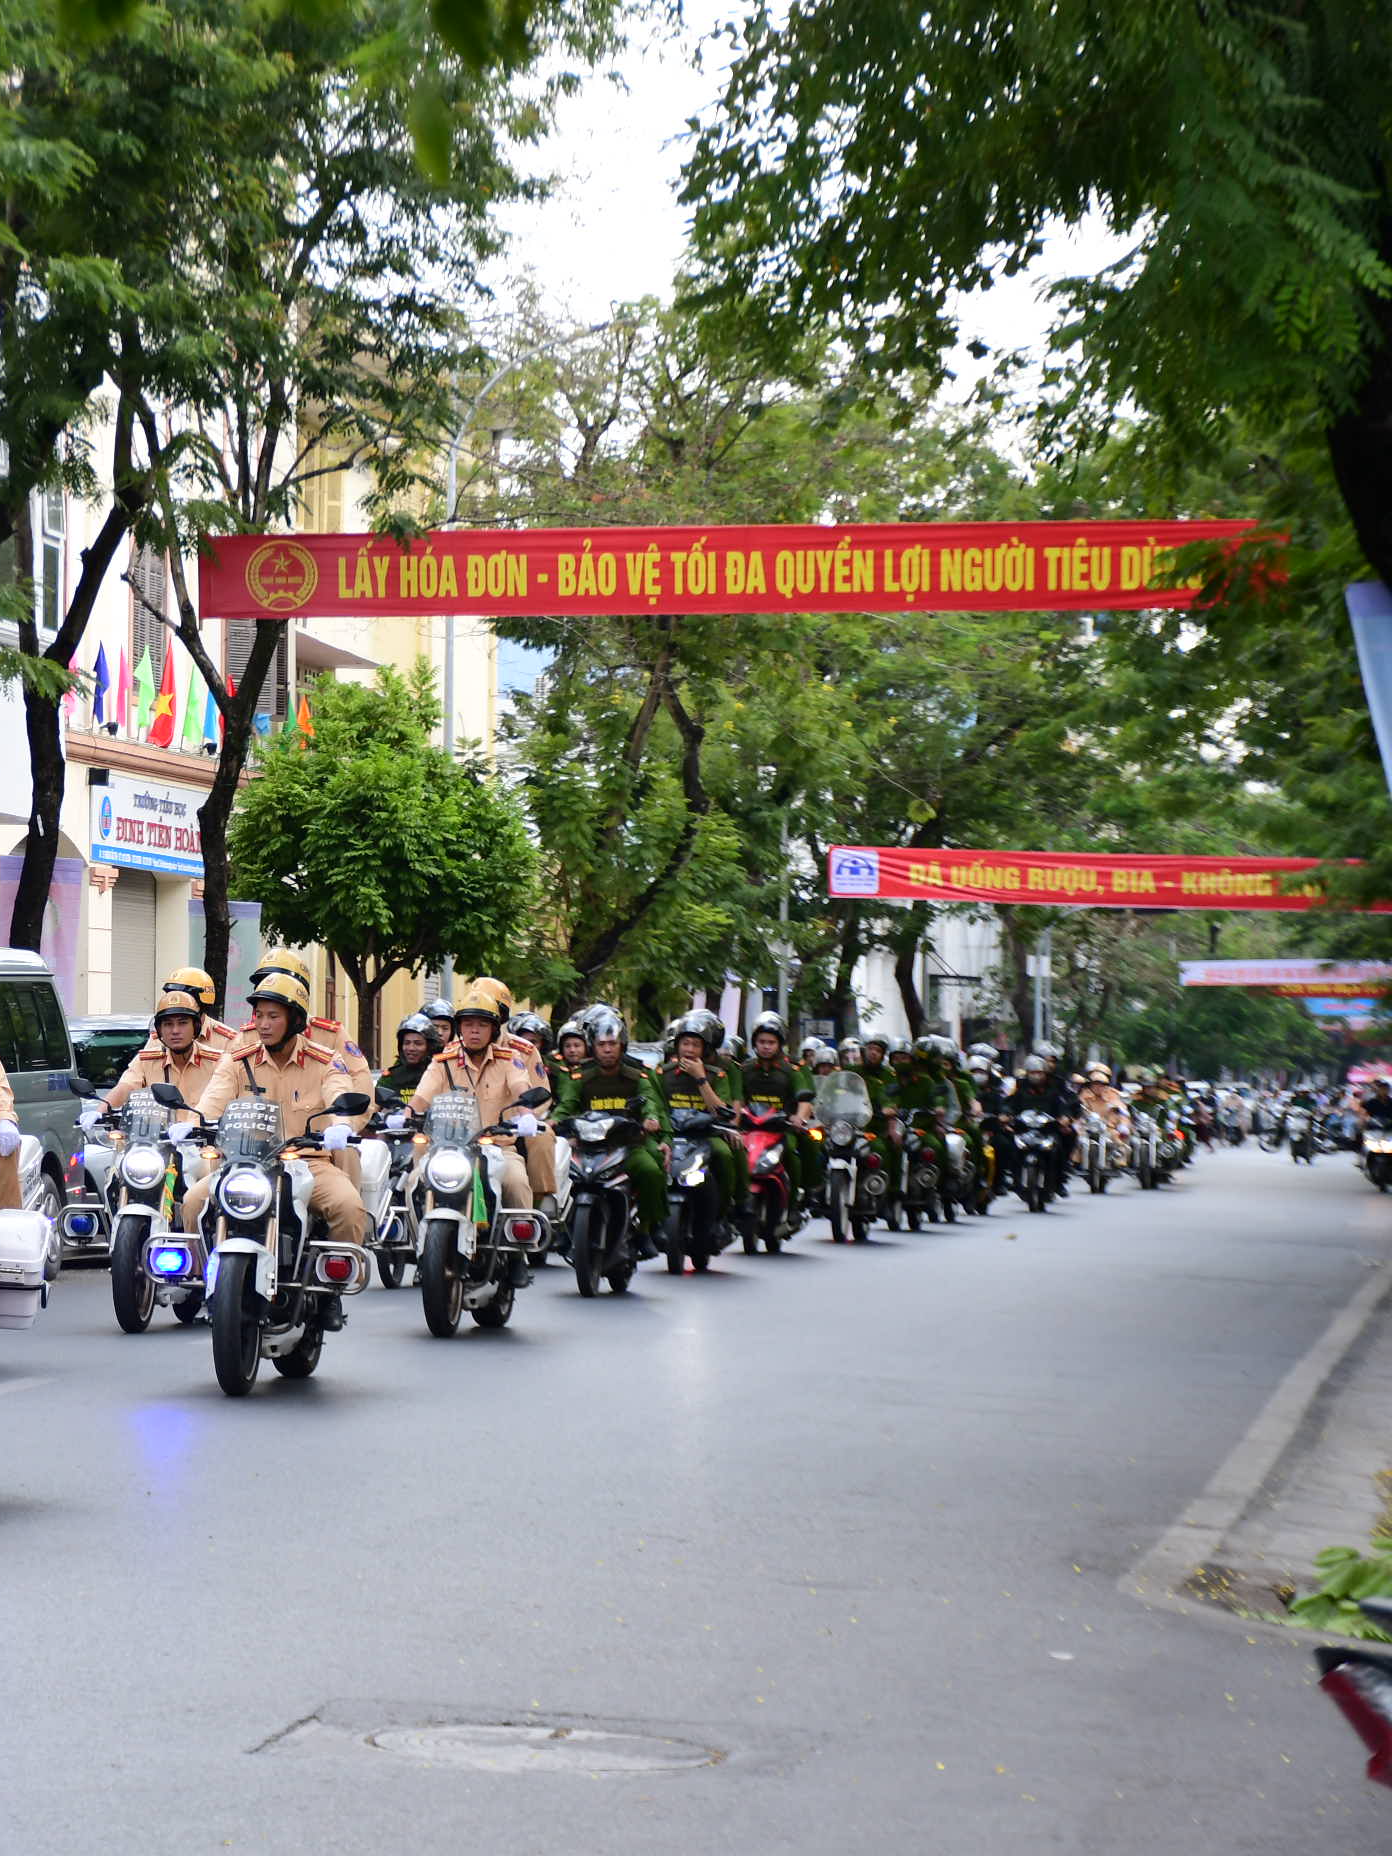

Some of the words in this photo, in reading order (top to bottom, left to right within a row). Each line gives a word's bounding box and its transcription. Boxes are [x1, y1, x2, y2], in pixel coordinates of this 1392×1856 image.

[338, 540, 390, 598] LẤY
[399, 545, 458, 598] HÓA
[466, 549, 528, 598] ĐƠN
[558, 537, 616, 596] BẢO
[625, 543, 661, 605] VỆ
[670, 536, 716, 595] TỐI
[725, 551, 767, 595] ĐA
[884, 544, 930, 602] LỢI
[940, 536, 1036, 592] NGƯỜI
[1043, 537, 1111, 591] TIÊU
[115, 816, 145, 845] ĐINH
[1112, 870, 1157, 894] BIA
[1181, 868, 1272, 897] KHÔNG
[432, 1095, 477, 1106] CSGT
[228, 1102, 279, 1114] CSGT
[432, 1104, 474, 1113] TRAFFIC
[126, 1109, 168, 1119] POLICE
[226, 1112, 278, 1123] TRAFFIC
[430, 1112, 476, 1121] POLICE
[224, 1122, 277, 1134] POLICE
